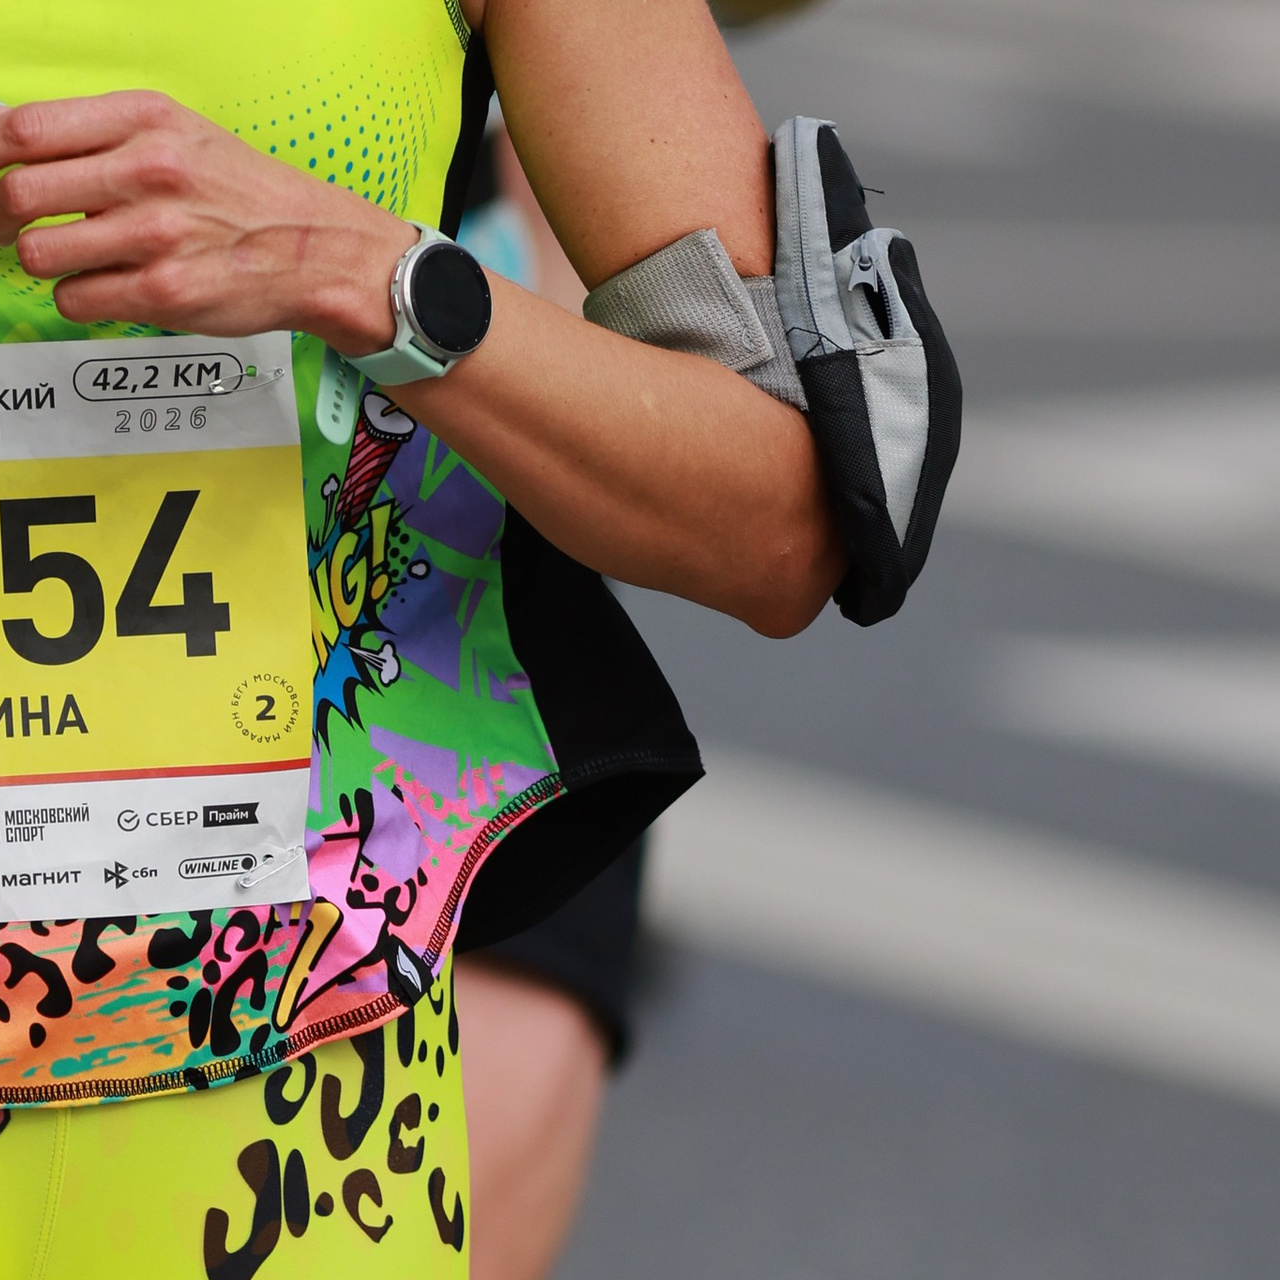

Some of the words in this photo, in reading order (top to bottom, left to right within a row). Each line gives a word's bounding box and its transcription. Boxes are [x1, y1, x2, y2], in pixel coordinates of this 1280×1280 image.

[92, 365, 159, 394] 42,2
[114, 406, 207, 434] 2026
[231, 680, 249, 707] БЕГУ
[252, 673, 300, 734] МОСКОВСКИЙ
[255, 694, 277, 722] 2
[231, 711, 282, 744] МАРАФОН
[4, 802, 90, 826] МОСКОВСКИЙ
[146, 810, 198, 827] СБЕР
[208, 808, 249, 823] Прайм
[6, 825, 46, 843] СПОРТ
[131, 866, 158, 879] сбп
[184, 859, 240, 875] WINLINE
